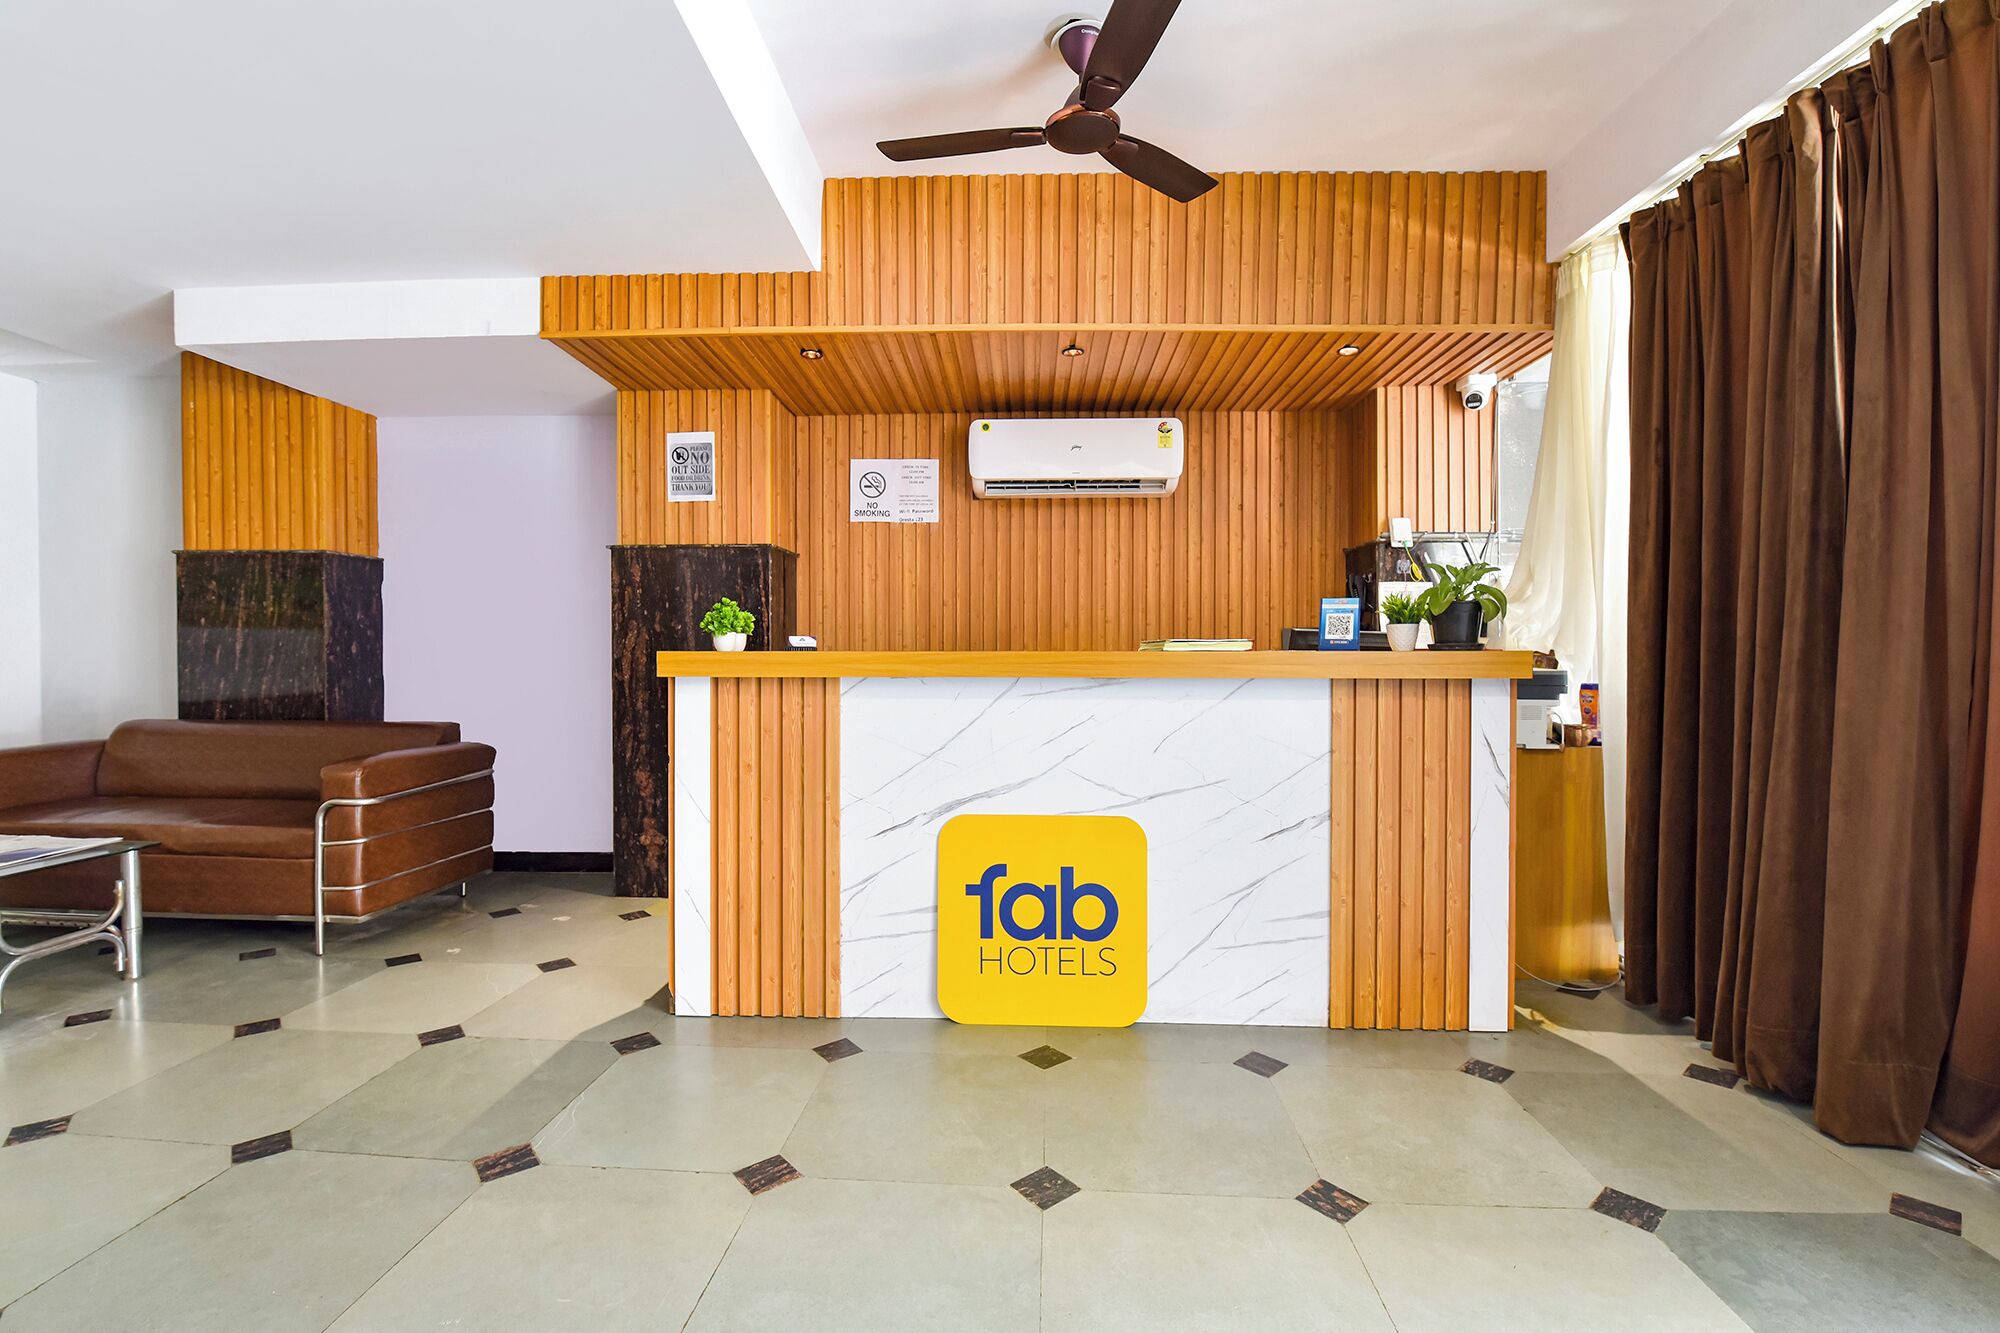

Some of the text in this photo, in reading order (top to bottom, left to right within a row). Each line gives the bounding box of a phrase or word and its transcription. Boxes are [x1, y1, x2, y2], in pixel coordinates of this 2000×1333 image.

[671, 465, 710, 474] OUT SIDE
[690, 452, 710, 465] NO
[965, 863, 1119, 942] fab
[980, 946, 1117, 977] HOTELS
